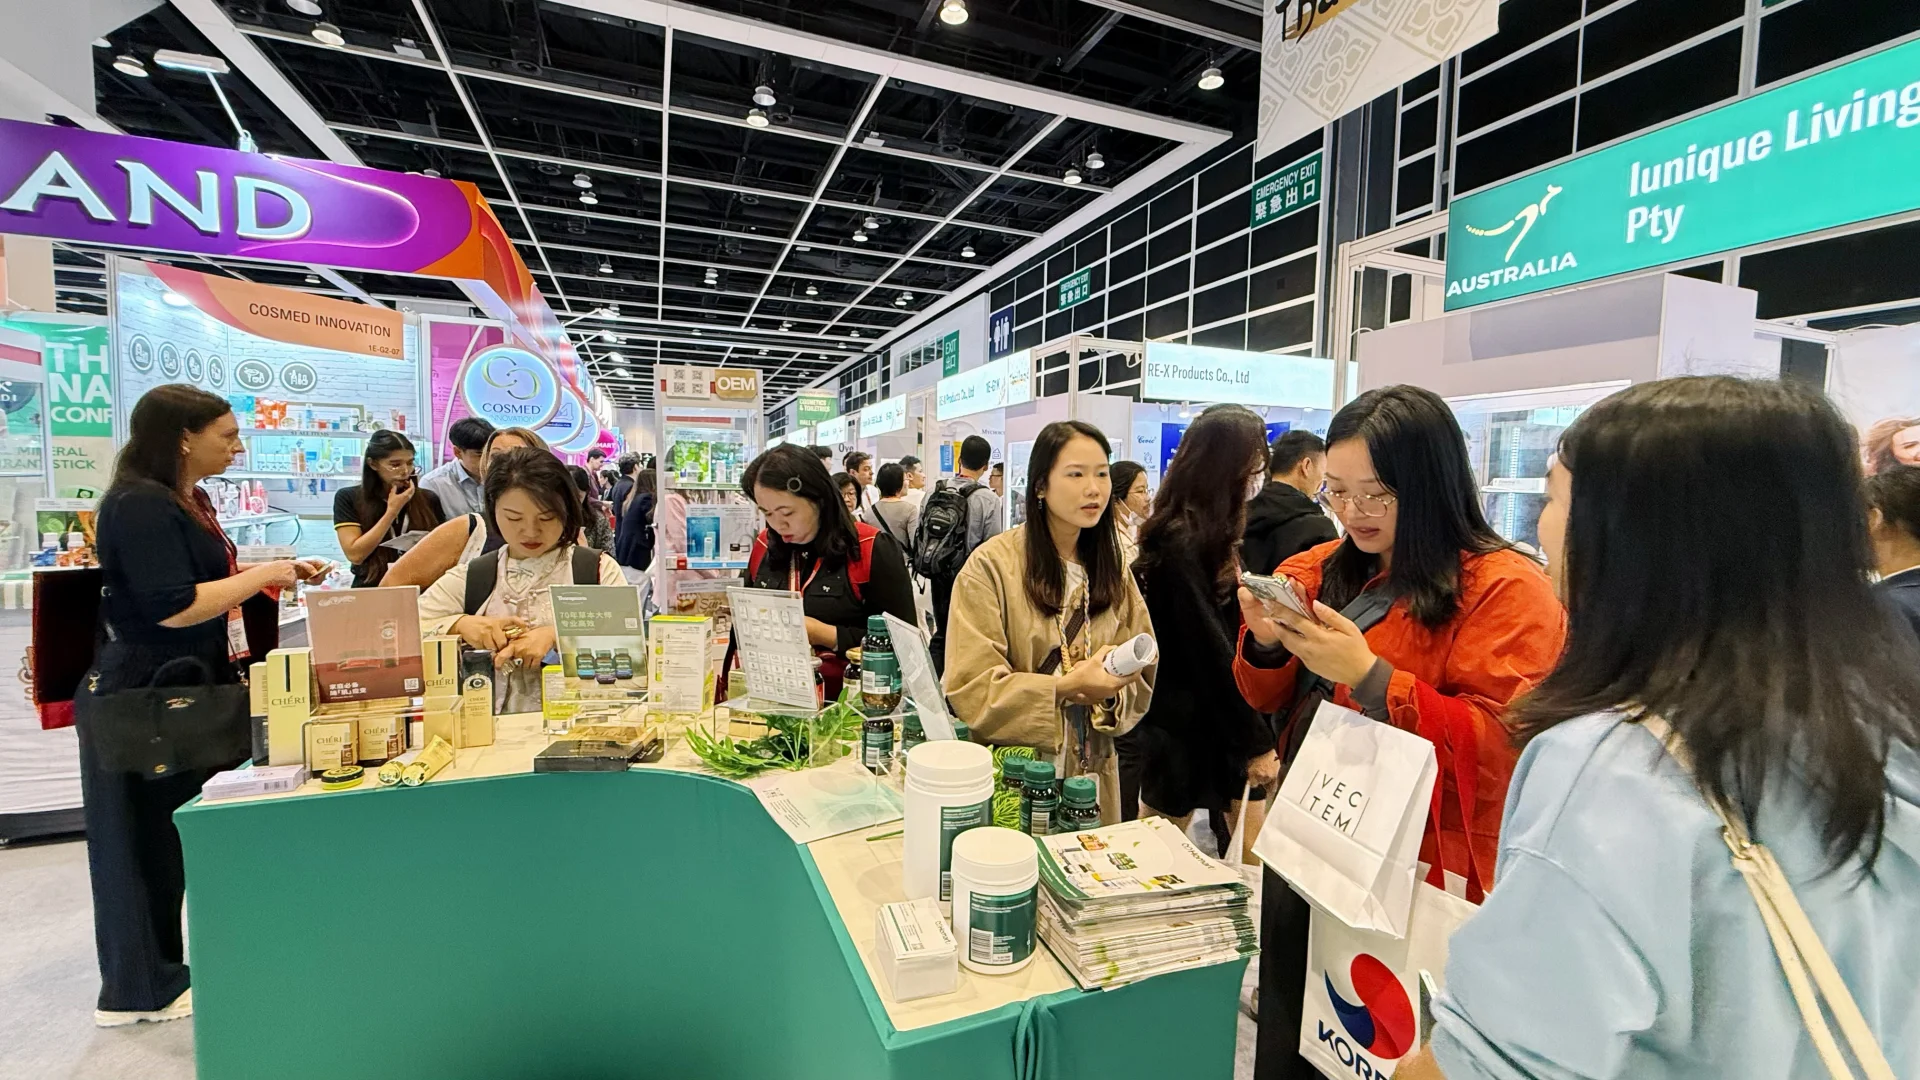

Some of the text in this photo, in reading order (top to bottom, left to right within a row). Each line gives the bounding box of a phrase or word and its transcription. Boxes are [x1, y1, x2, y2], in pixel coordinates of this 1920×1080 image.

[1629, 83, 1920, 198] Iunique Living
[1256, 161, 1317, 201] EMERGENCY EXIT
[0, 150, 312, 240] AND
[1256, 179, 1316, 221] 緊急出口
[1626, 203, 1685, 245] Pty
[1446, 251, 1578, 298] AUSTRALIA
[249, 303, 391, 338] COSMED INNOVATION
[368, 344, 400, 356] 1E-G2-07
[946, 338, 956, 354] EXIT
[717, 376, 755, 391] OEM
[1148, 363, 1250, 384] RE-X Products Co., Ltd
[482, 402, 540, 414] COSMED
[426, 678, 454, 686] CHÉRI
[272, 695, 305, 706] CHÉRI
[316, 736, 342, 744] CHÉRI
[364, 726, 388, 735] CHÉRI
[1322, 774, 1362, 808] VEC
[1310, 796, 1352, 832] TEM
